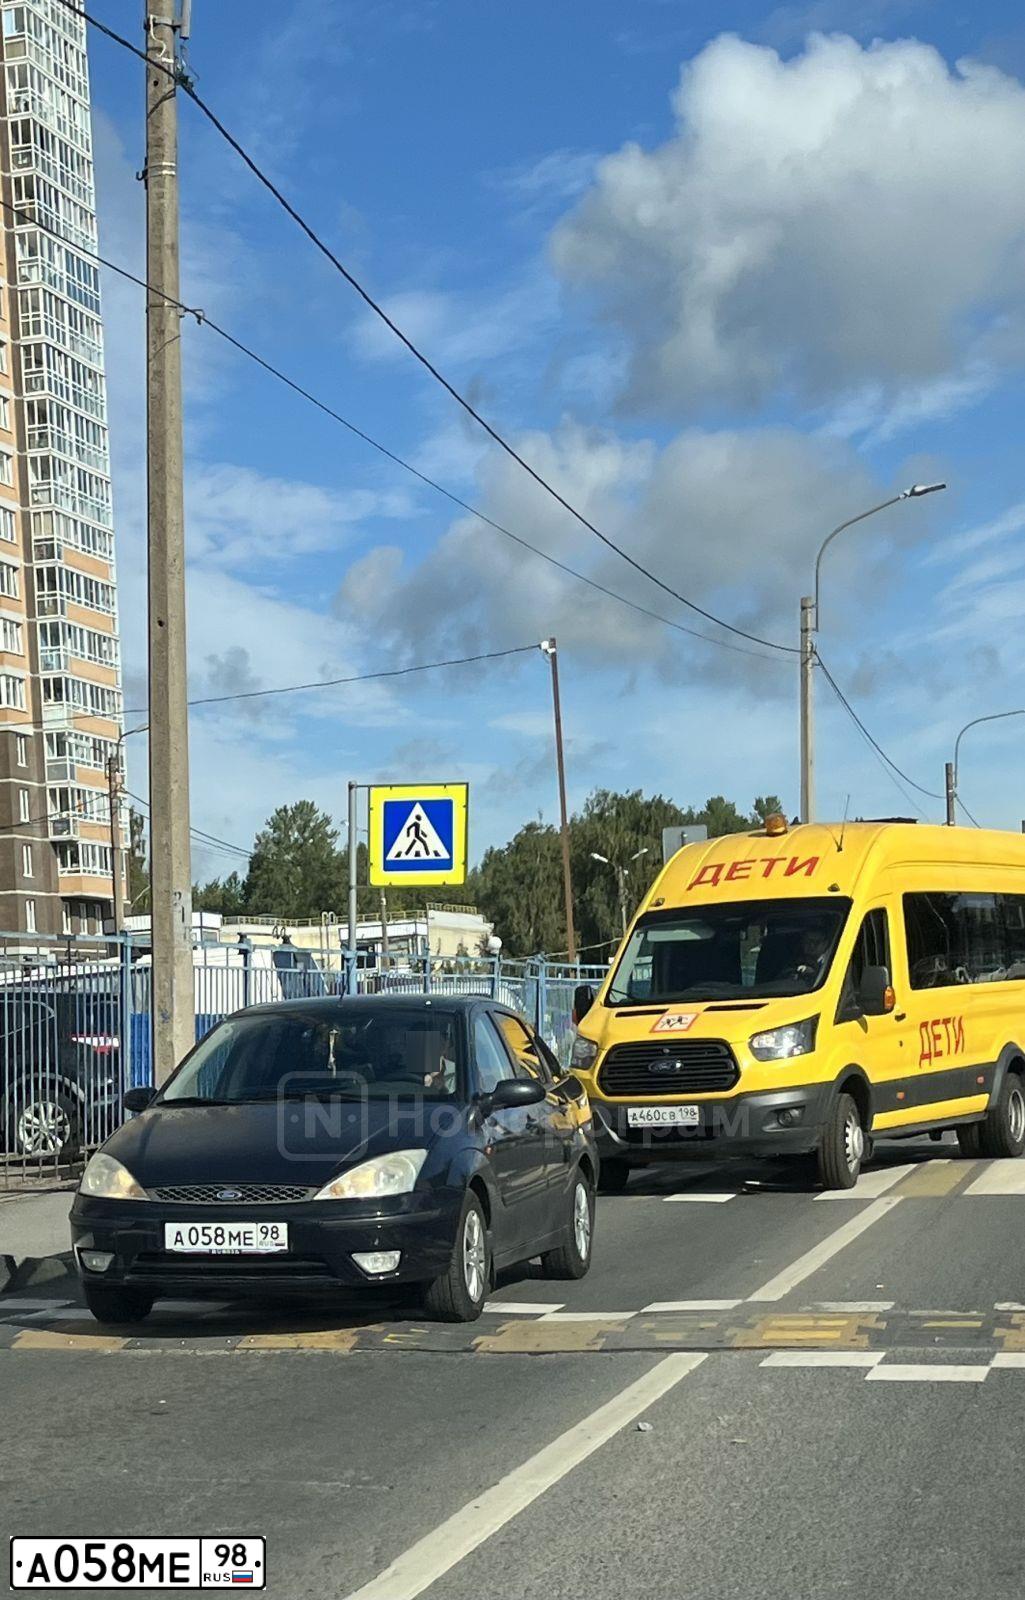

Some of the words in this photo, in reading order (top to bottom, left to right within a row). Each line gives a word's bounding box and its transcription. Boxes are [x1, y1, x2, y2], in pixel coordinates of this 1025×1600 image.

[686, 856, 819, 891] ДЕТИ
[919, 1016, 965, 1069] ДЕТИ
[174, 1226, 254, 1246] А058МЕ
[259, 1225, 280, 1240] 98
